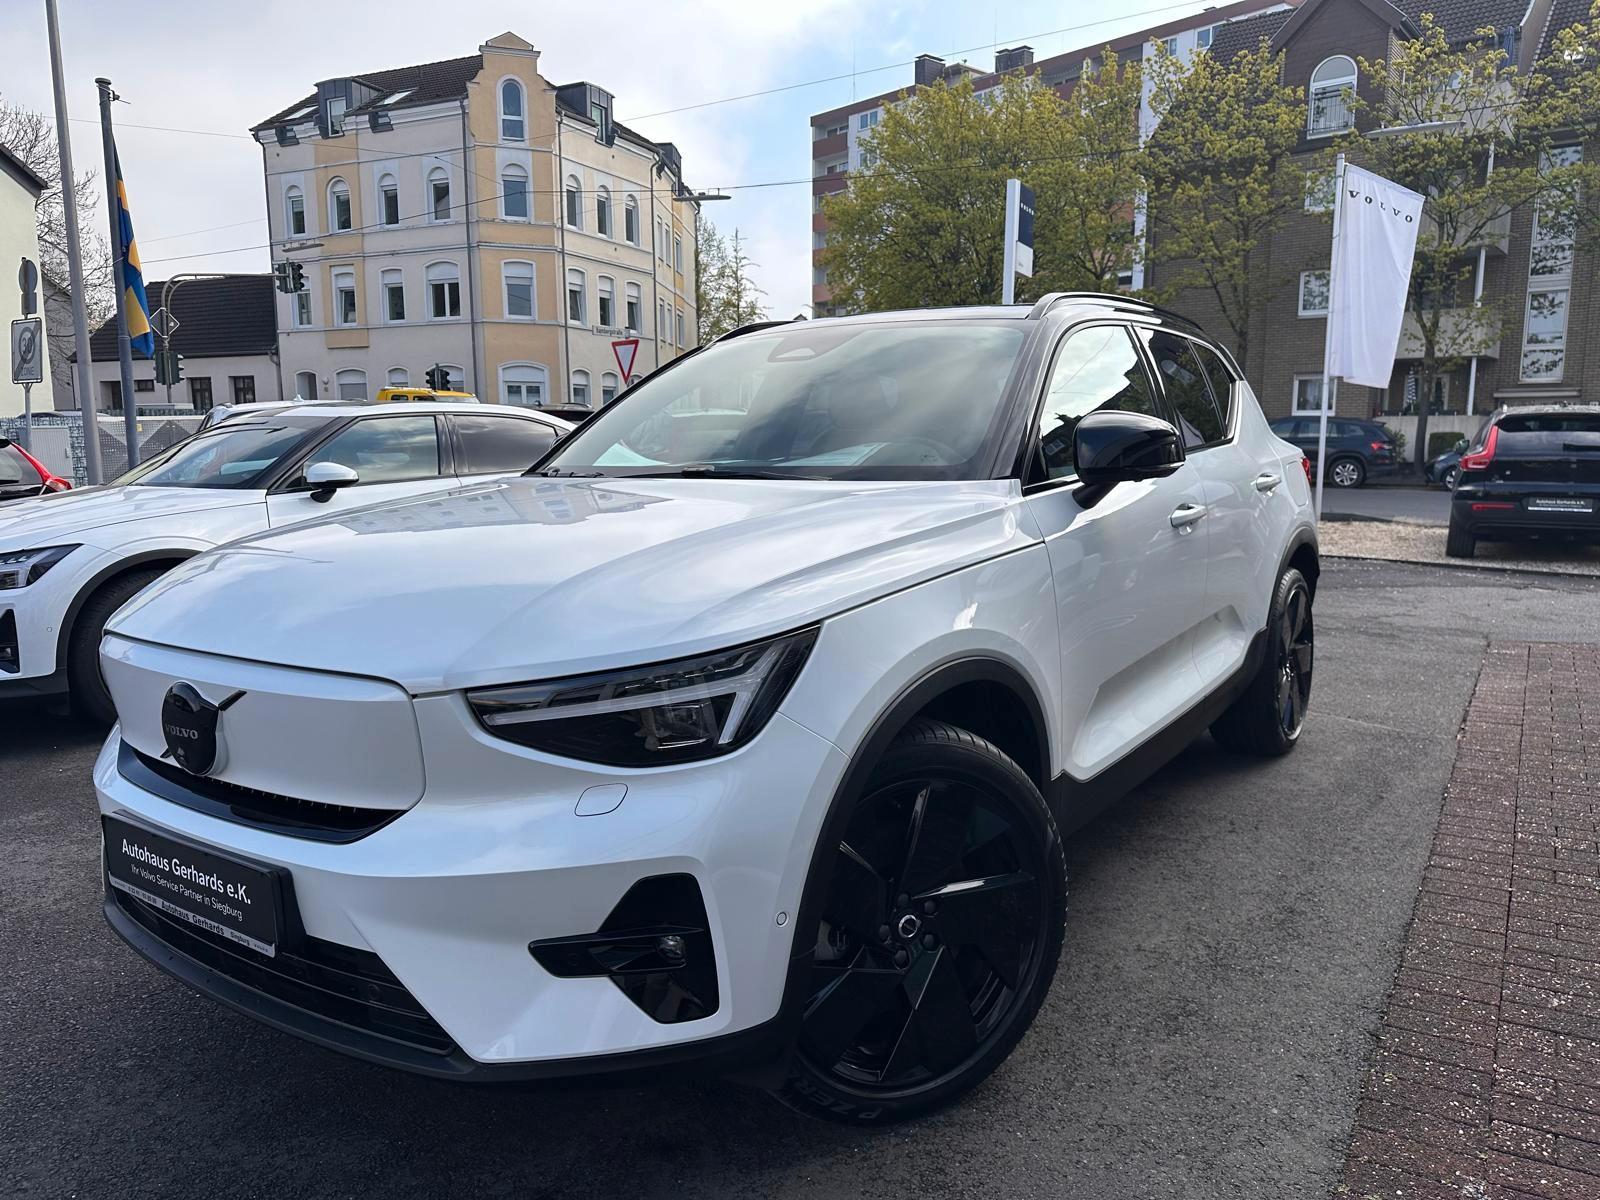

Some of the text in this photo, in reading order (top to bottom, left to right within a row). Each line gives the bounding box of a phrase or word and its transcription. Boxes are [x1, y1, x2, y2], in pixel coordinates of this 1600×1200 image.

[1347, 190, 1413, 223] VOLVO
[21, 336, 33, 354] 30
[165, 722, 199, 740] VOLVO
[122, 838, 252, 905] Autohaus Gerhards e.K.
[130, 863, 243, 922] Ihr Volvo Service Partner in Siegburg
[161, 900, 190, 921] Autohaus
[192, 914, 225, 936] Gerhards
